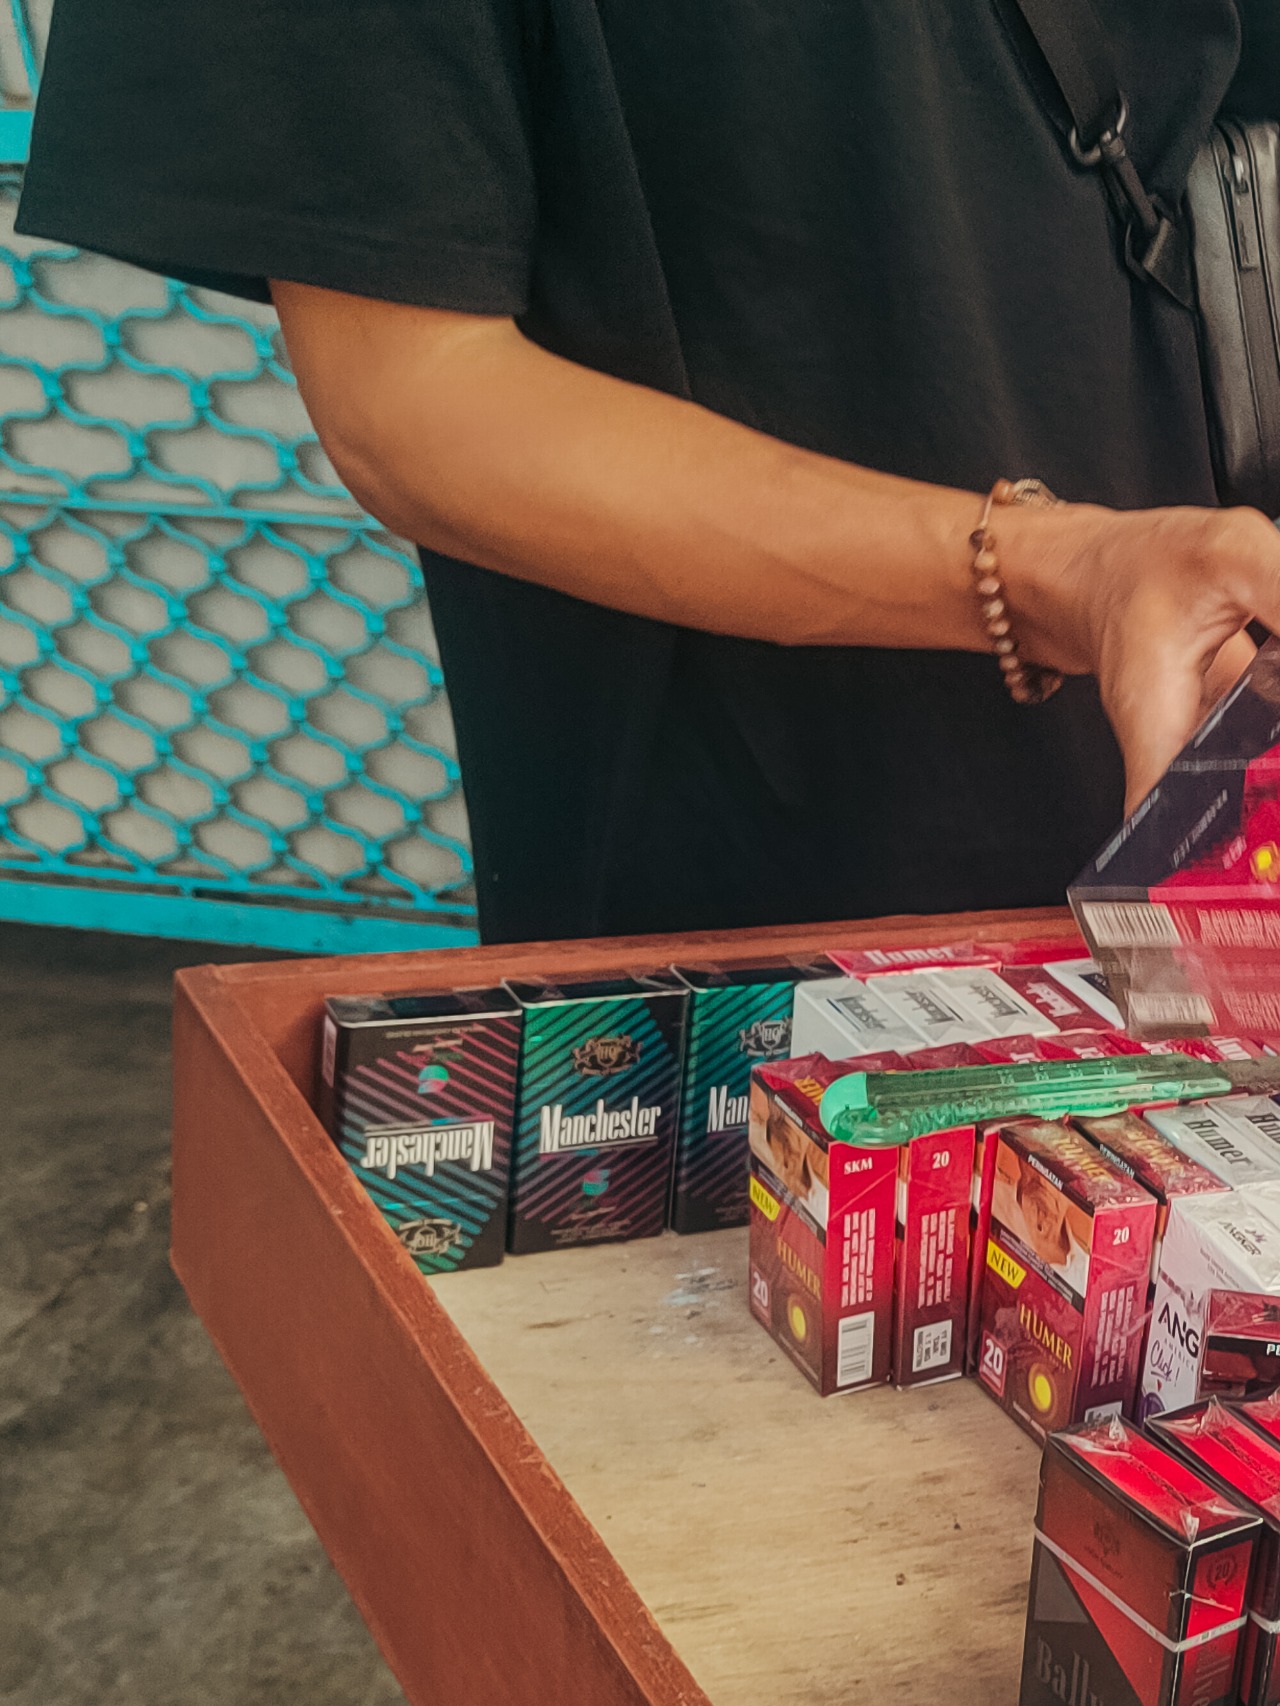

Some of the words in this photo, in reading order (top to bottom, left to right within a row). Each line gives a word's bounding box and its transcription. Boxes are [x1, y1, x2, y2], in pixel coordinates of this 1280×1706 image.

[539, 1096, 661, 1154] Manchester
[1184, 1119, 1252, 1167] Humer
[361, 1121, 495, 1180] Manchester
[843, 1157, 873, 1176] SKM
[932, 1151, 950, 1169] 20
[1028, 1154, 1064, 1191] PERINGATAN
[1112, 1227, 1130, 1245] 20
[777, 1236, 821, 1300] HUMER
[991, 1250, 1020, 1281] NEW
[753, 1272, 769, 1308] 20
[1020, 1303, 1073, 1371] HUMER
[984, 1339, 1003, 1375] 20
[1214, 1563, 1231, 1580] 20
